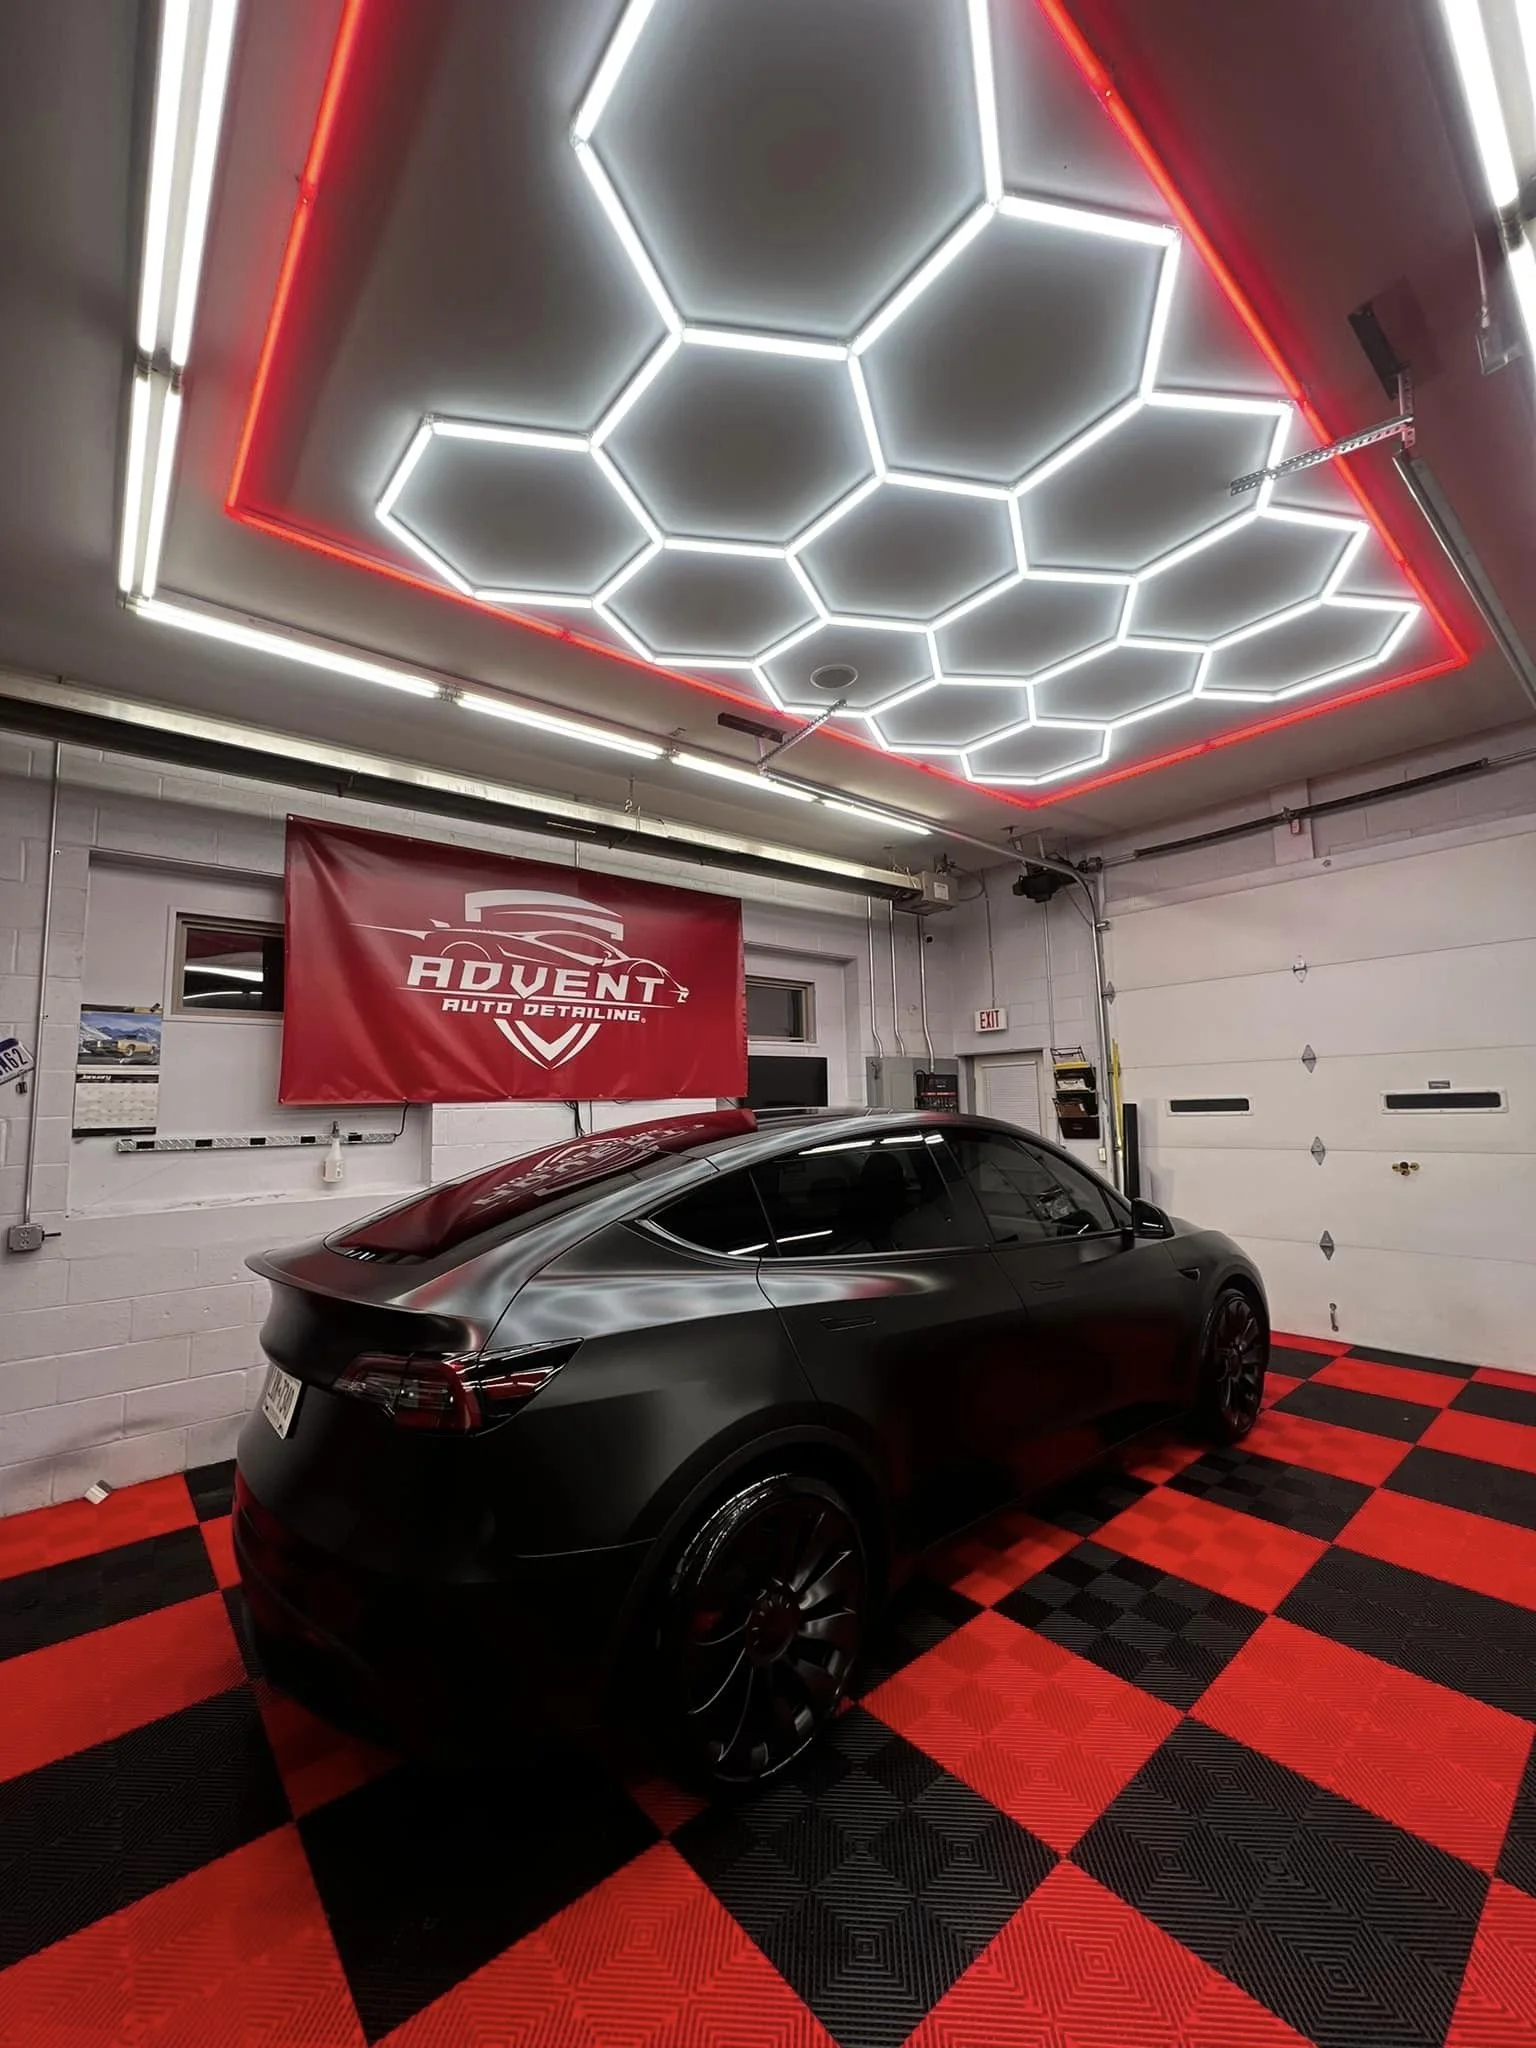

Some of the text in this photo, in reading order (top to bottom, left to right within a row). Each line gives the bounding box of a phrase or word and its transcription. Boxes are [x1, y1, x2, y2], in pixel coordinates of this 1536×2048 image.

[407, 955, 665, 1003] ADVENT
[442, 998, 641, 1022] AUTO DETAILING
[980, 1010, 1000, 1029] EXIT
